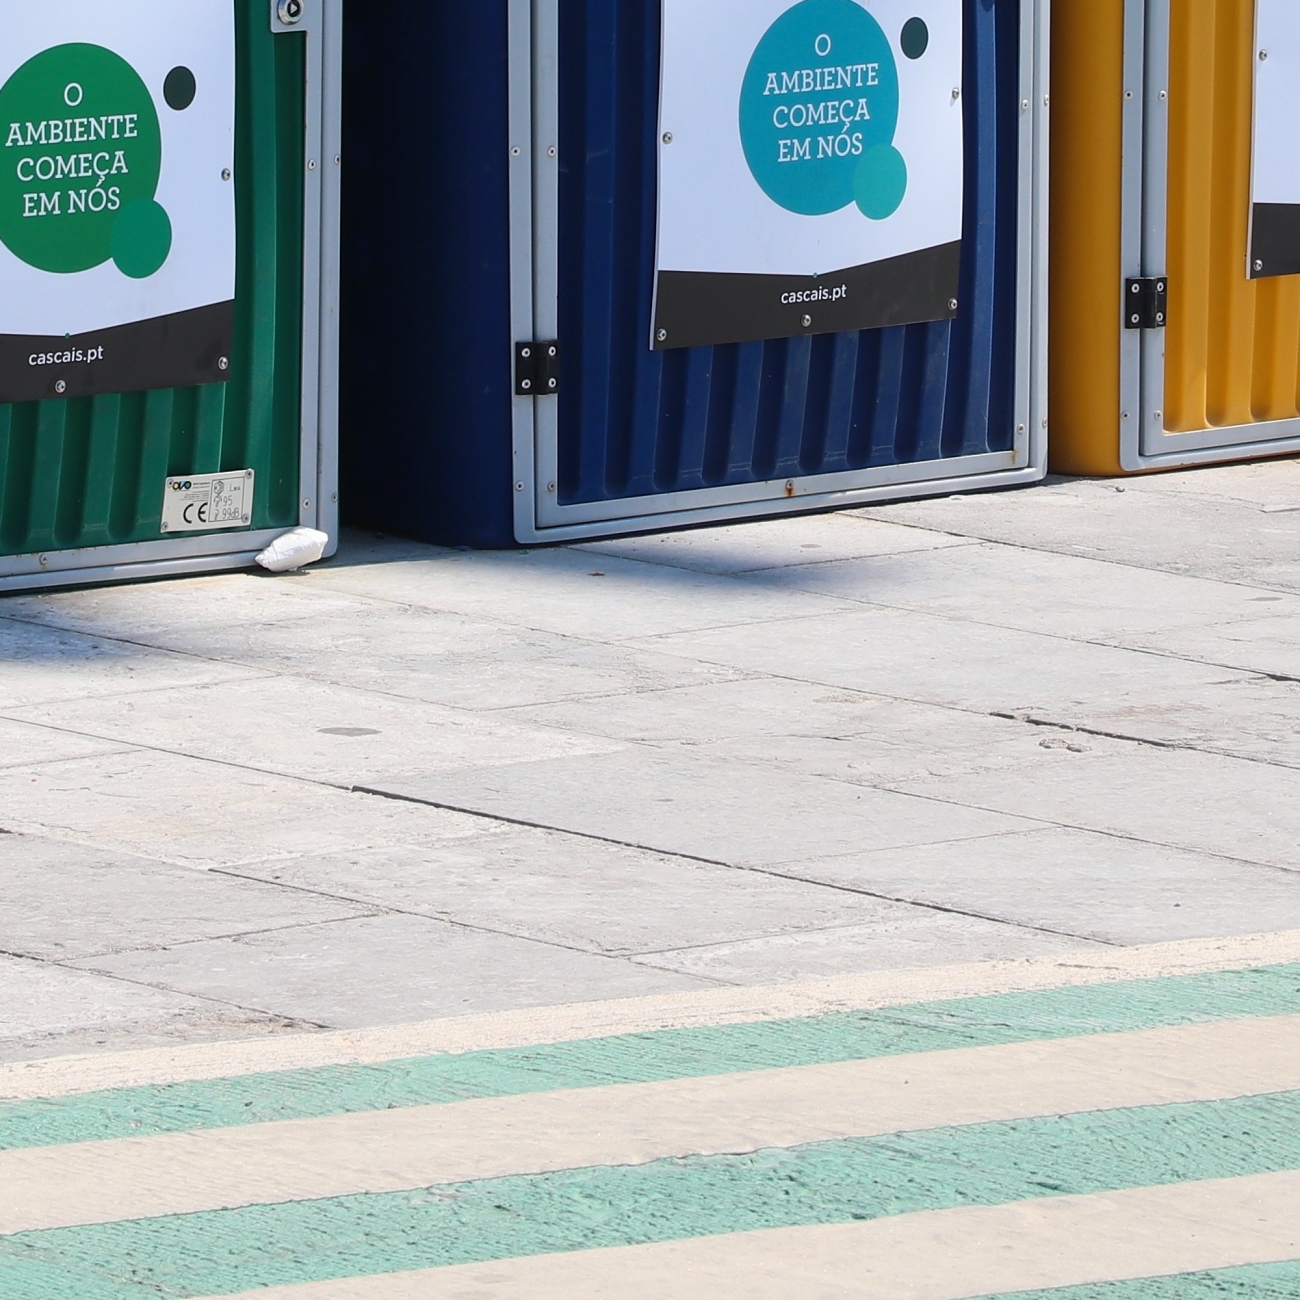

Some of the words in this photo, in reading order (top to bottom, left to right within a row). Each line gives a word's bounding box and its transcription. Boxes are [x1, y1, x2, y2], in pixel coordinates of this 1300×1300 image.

[814, 33, 832, 57] O
[63, 82, 83, 107] O
[762, 62, 879, 96] AMBIENTE
[773, 98, 871, 129] COMEÇA
[4, 113, 138, 147] AMBIENTE
[777, 138, 812, 163] EM
[816, 124, 863, 158] NÓS
[16, 150, 129, 182] COMEÇA
[22, 191, 61, 217] EM
[67, 179, 121, 214] NÓS
[780, 284, 847, 304] cascais.pt
[28, 345, 104, 366] cascais.pt
[182, 501, 208, 524] CE
